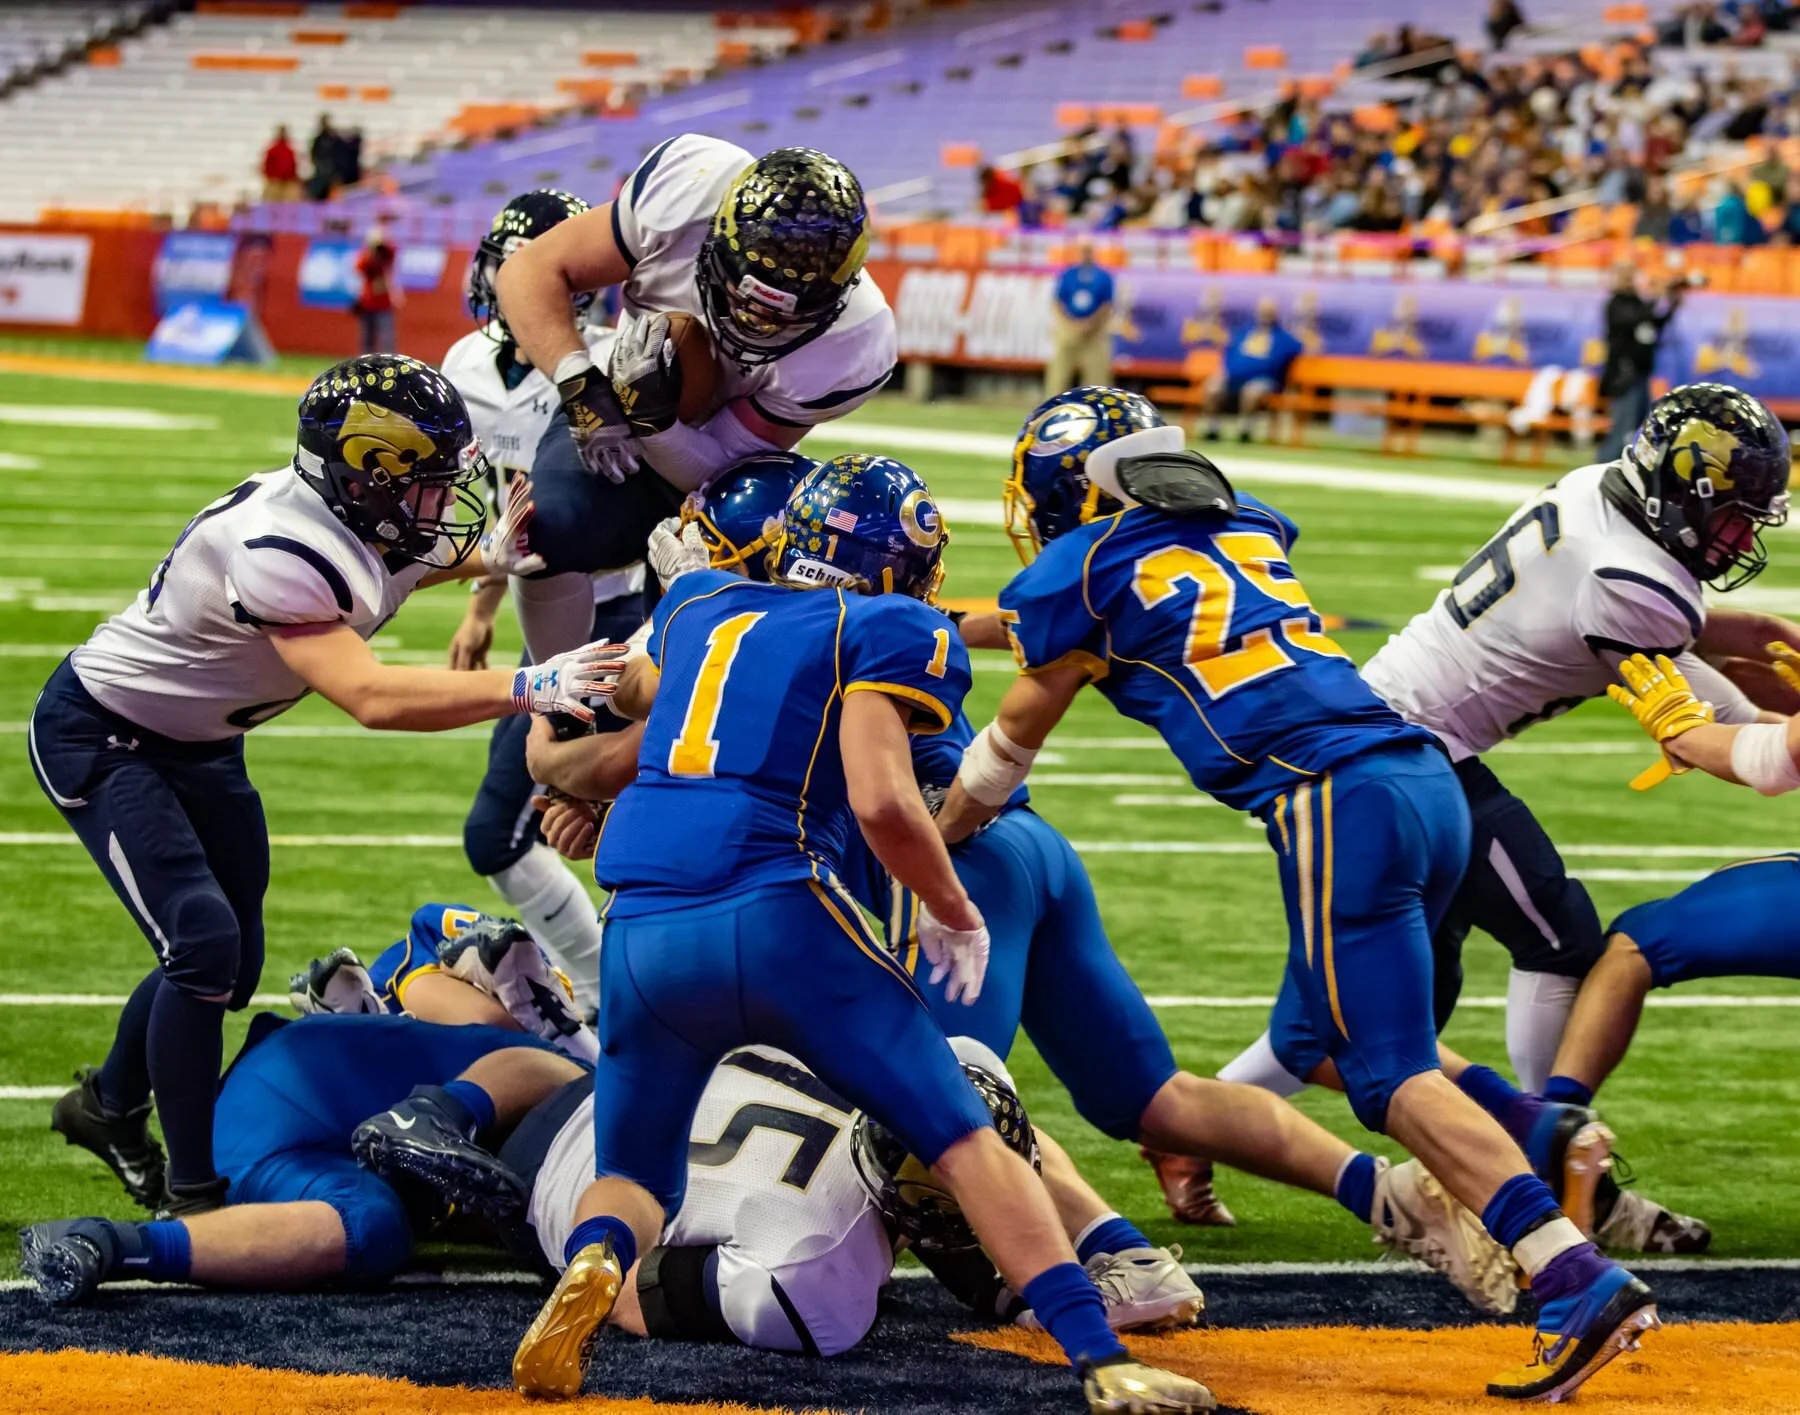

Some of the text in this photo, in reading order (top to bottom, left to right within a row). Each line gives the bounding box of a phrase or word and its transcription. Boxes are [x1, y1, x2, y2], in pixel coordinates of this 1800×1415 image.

[899, 489, 942, 548] G
[925, 628, 949, 680] 1
[1131, 532, 1355, 700] 25
[668, 611, 769, 779] 1
